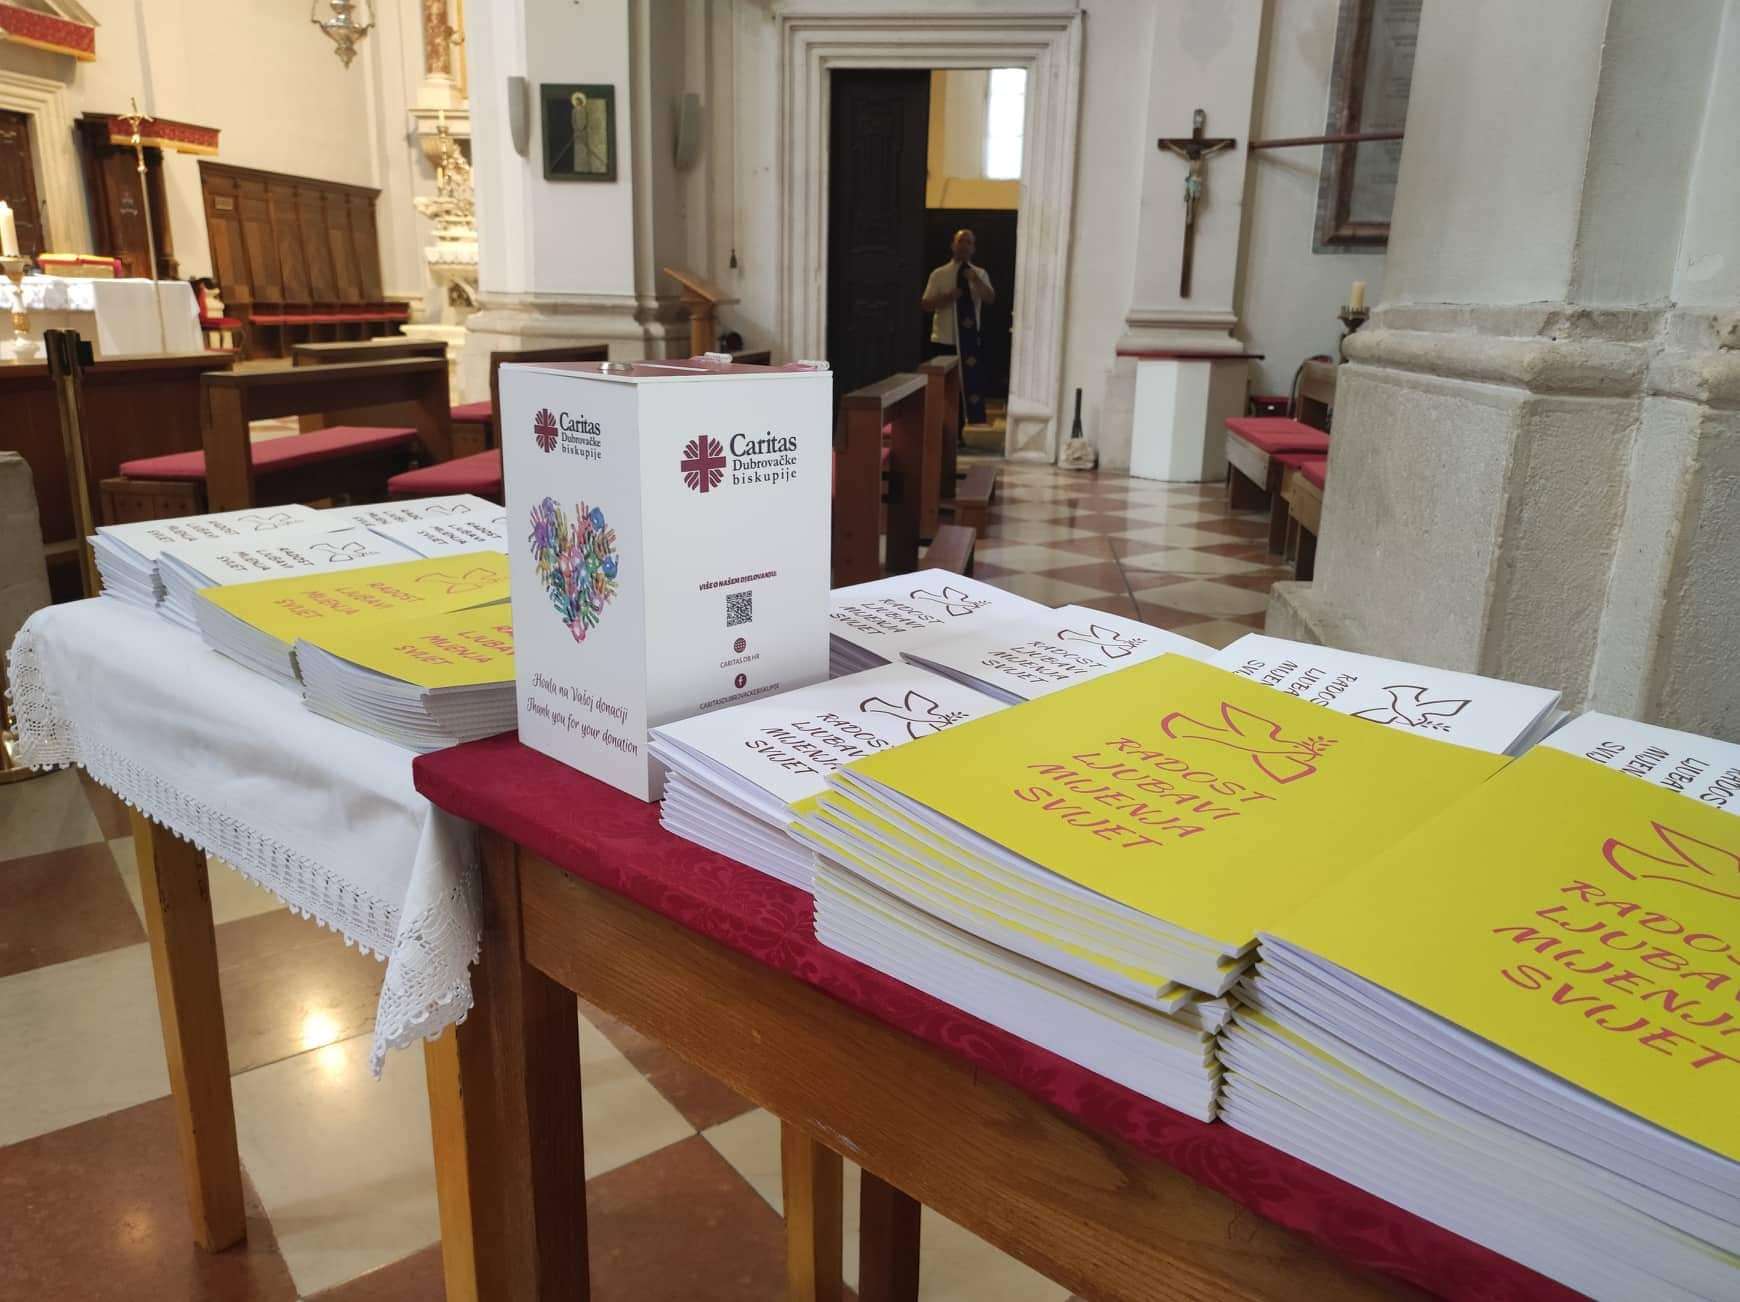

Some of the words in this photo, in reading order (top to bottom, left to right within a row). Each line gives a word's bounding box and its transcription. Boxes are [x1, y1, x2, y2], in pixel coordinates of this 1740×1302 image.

[560, 412, 601, 436] Caritas
[562, 432, 601, 447] Dubrovačke
[562, 444, 602, 461] biskupije
[730, 431, 797, 457] Caritas
[733, 455, 797, 471] Dubrovačke
[733, 467, 797, 485] biskupije
[699, 580, 713, 591] VIŠE
[829, 613, 886, 635] SVIJET
[838, 606, 907, 632] MIJENJA
[861, 603, 926, 628] LJUBAVI
[878, 599, 944, 624] RADOST
[457, 630, 514, 655] LJUBA
[1027, 641, 1107, 668] RADOST
[981, 659, 1049, 683] SVIJET
[987, 651, 1070, 680] MIJENJA
[1010, 647, 1088, 674] LJUBAVI
[1260, 659, 1299, 686] MIJEN
[1282, 667, 1327, 697] LJUBA
[1310, 673, 1358, 707] RADOS
[560, 686, 569, 699] na
[571, 686, 594, 712] Vašoj
[596, 698, 628, 725] donaciji
[527, 697, 550, 719] Thank
[552, 711, 565, 726] you
[567, 713, 580, 732] for
[581, 722, 600, 740] your
[602, 729, 639, 756] donation
[791, 721, 870, 757] LJUBAV
[816, 712, 891, 749] RADOS
[745, 740, 819, 774] SVIJET
[1585, 741, 1625, 764] SVIJ
[1620, 745, 1670, 778] MIJEN
[1105, 737, 1277, 802] RADOST
[1660, 757, 1711, 793] LJUBA
[1072, 752, 1241, 820] LJUBAVI
[1027, 764, 1206, 838] MIJENJA
[1013, 786, 1164, 848] SVIJET
[1560, 880, 1740, 966] RADO
[1536, 905, 1740, 1001] LJUBA
[1492, 926, 1740, 1036] MIJENJ
[1501, 965, 1740, 1069] SVIJET
